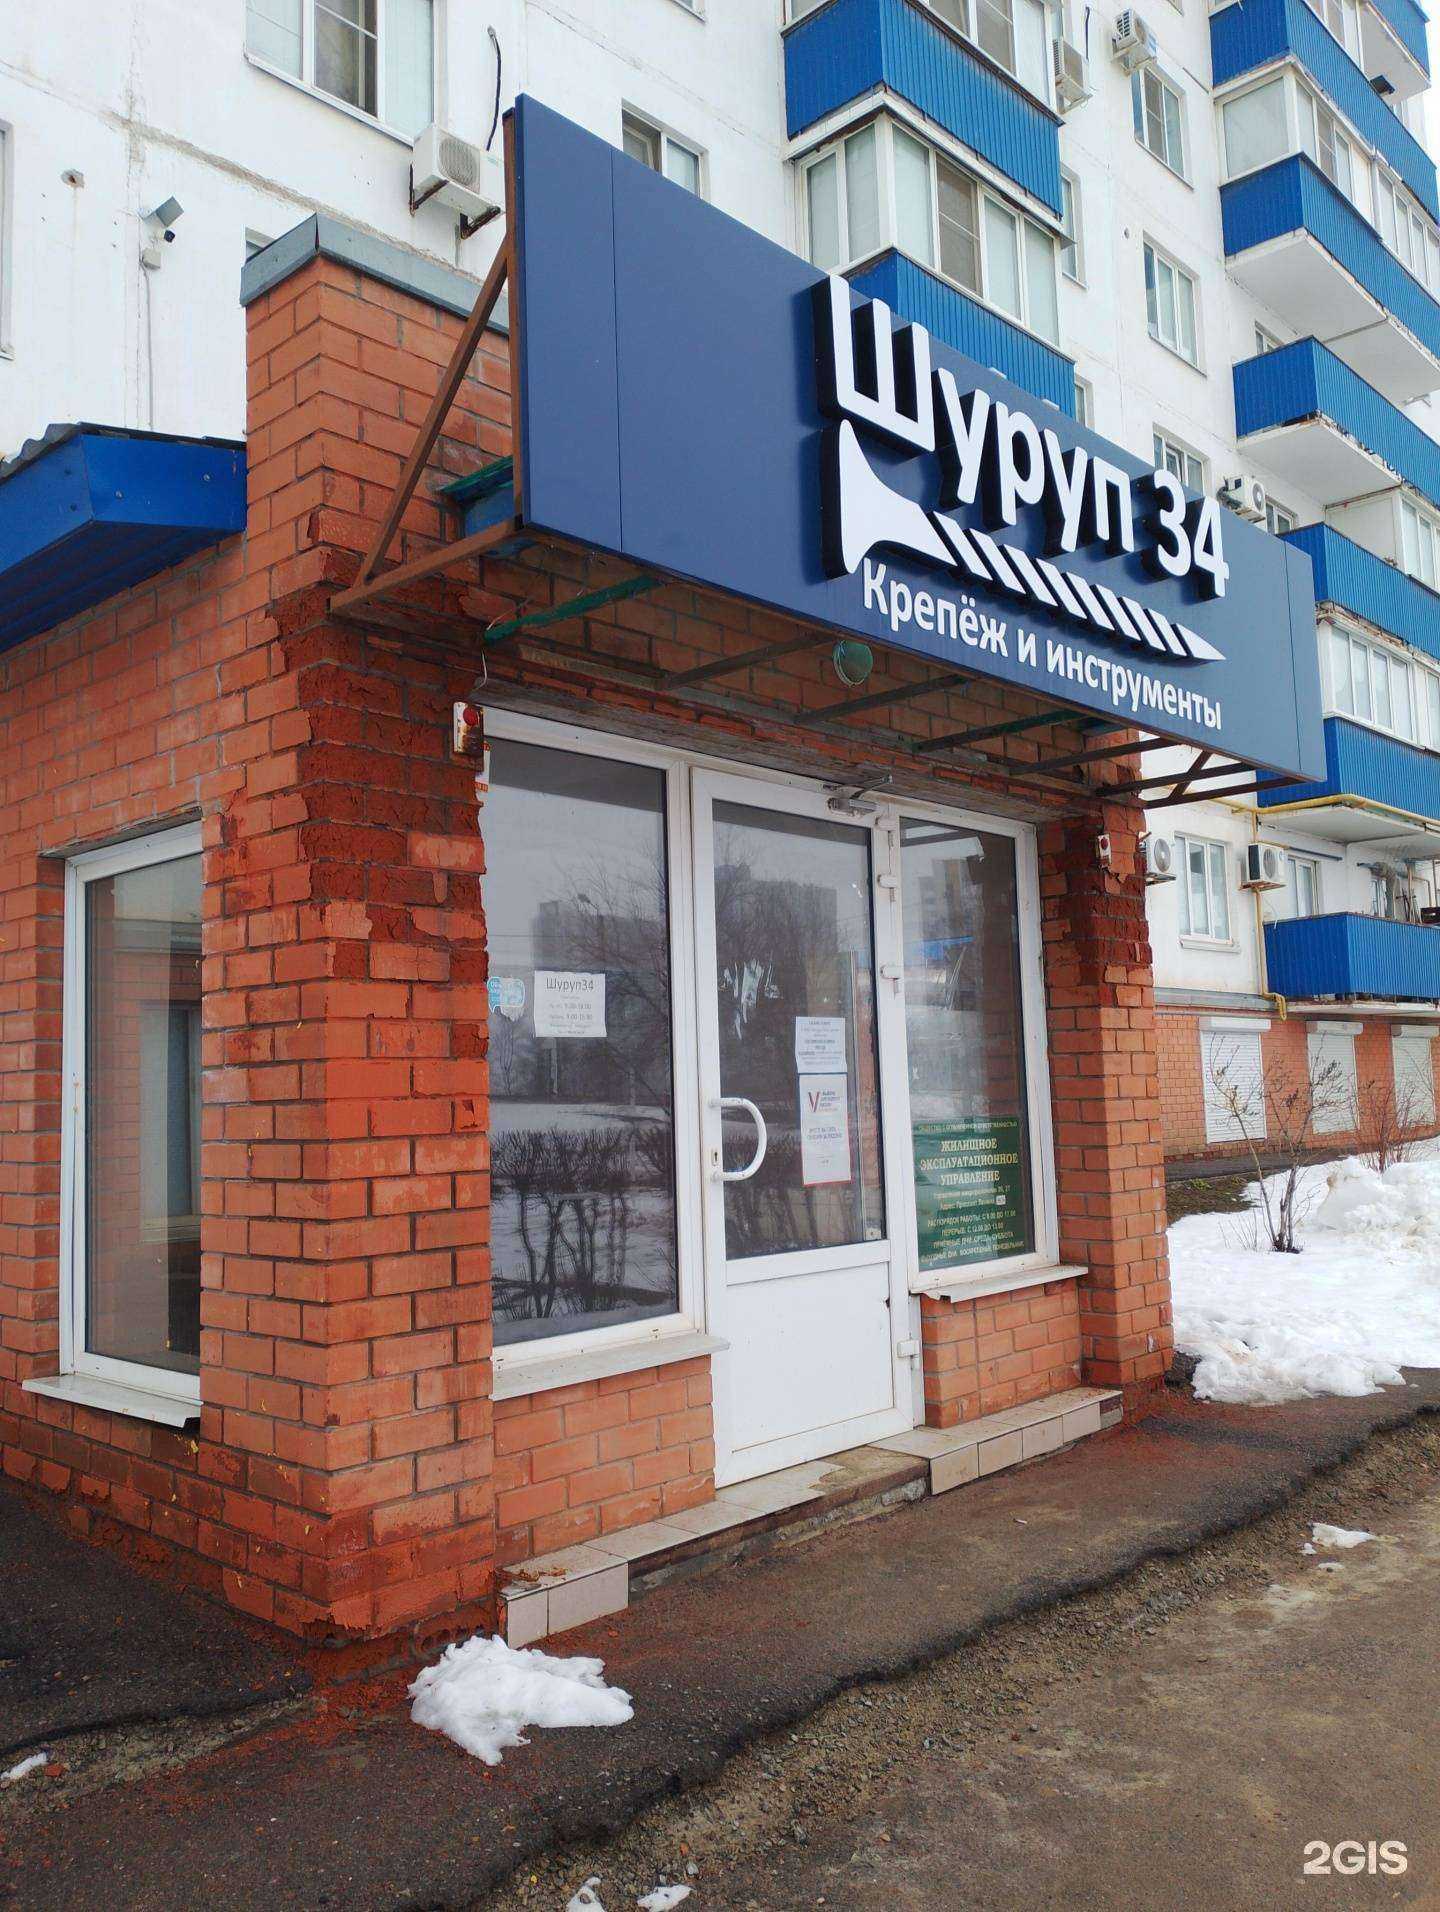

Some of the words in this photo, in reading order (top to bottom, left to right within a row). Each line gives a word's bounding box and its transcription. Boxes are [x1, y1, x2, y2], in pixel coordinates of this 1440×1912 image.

[829, 274, 1135, 552] Шуруп
[1153, 468, 1230, 598] 34
[862, 557, 1008, 657] Крепёж
[1017, 628, 1037, 667] и
[1046, 642, 1223, 731] инструменты
[546, 978, 594, 992] Шуруп34
[941, 1138, 998, 1152] ЖИЛИЩНОЕ
[920, 1153, 1019, 1170] ЭКСПЛУАТАЦИОННОЕ
[940, 1170, 1000, 1186] УПРАВЛЕНИЕ
